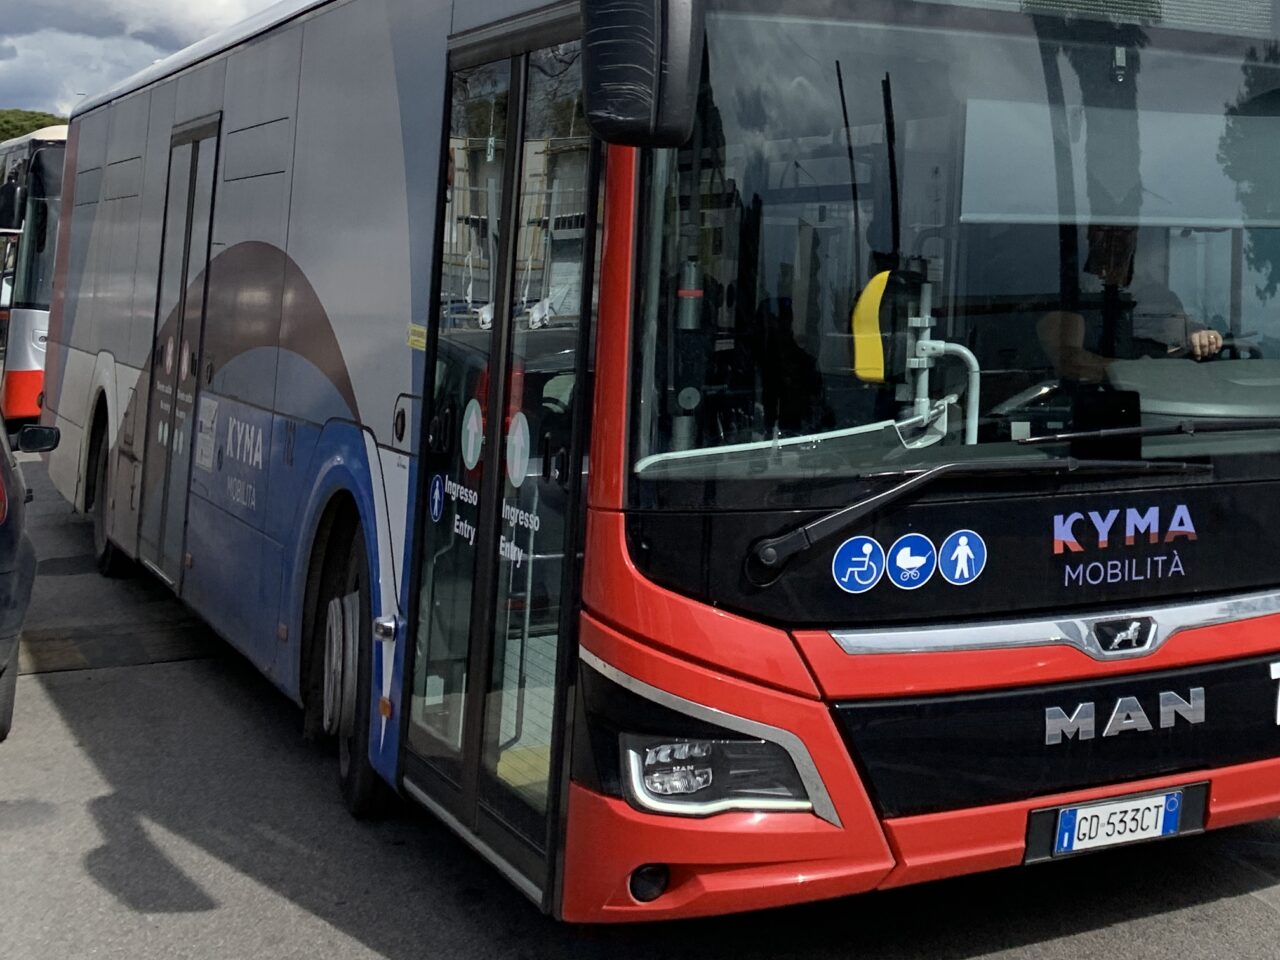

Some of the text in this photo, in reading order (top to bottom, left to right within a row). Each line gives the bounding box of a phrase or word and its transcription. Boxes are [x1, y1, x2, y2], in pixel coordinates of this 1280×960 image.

[226, 416, 264, 470] KYMA
[445, 474, 478, 506] Ingresso
[454, 514, 476, 546] Entry
[502, 498, 540, 532] Ingresso
[1053, 504, 1198, 555] KYMA
[500, 535, 524, 569] Entry
[1064, 550, 1186, 587] MOBILITÀ
[1045, 687, 1206, 746] MAN
